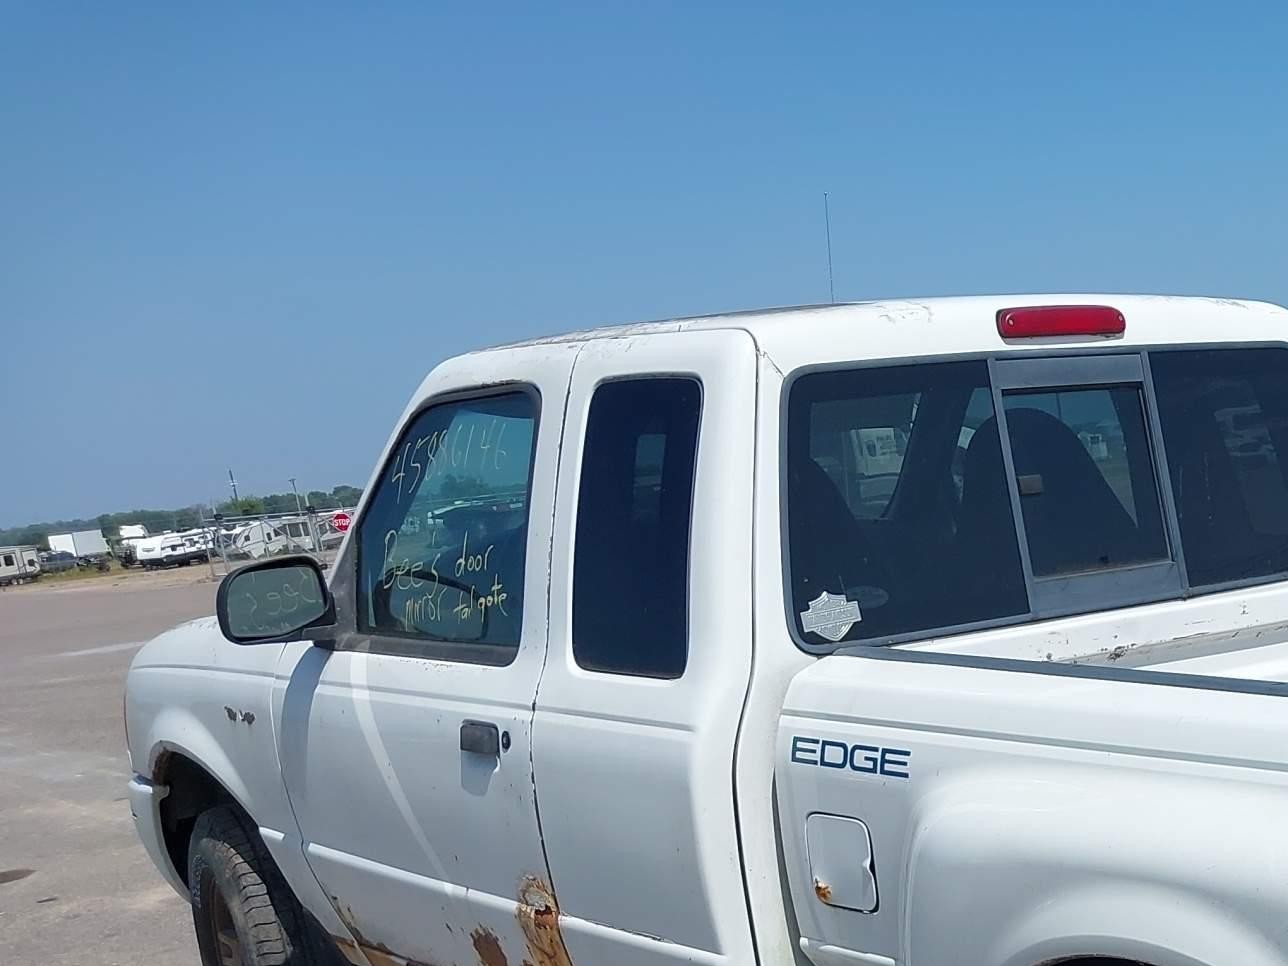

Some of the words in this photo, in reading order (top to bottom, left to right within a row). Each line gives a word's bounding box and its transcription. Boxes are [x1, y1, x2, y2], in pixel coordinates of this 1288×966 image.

[334, 518, 350, 528] STOP
[455, 530, 494, 577] door
[791, 735, 911, 778] EDGE
